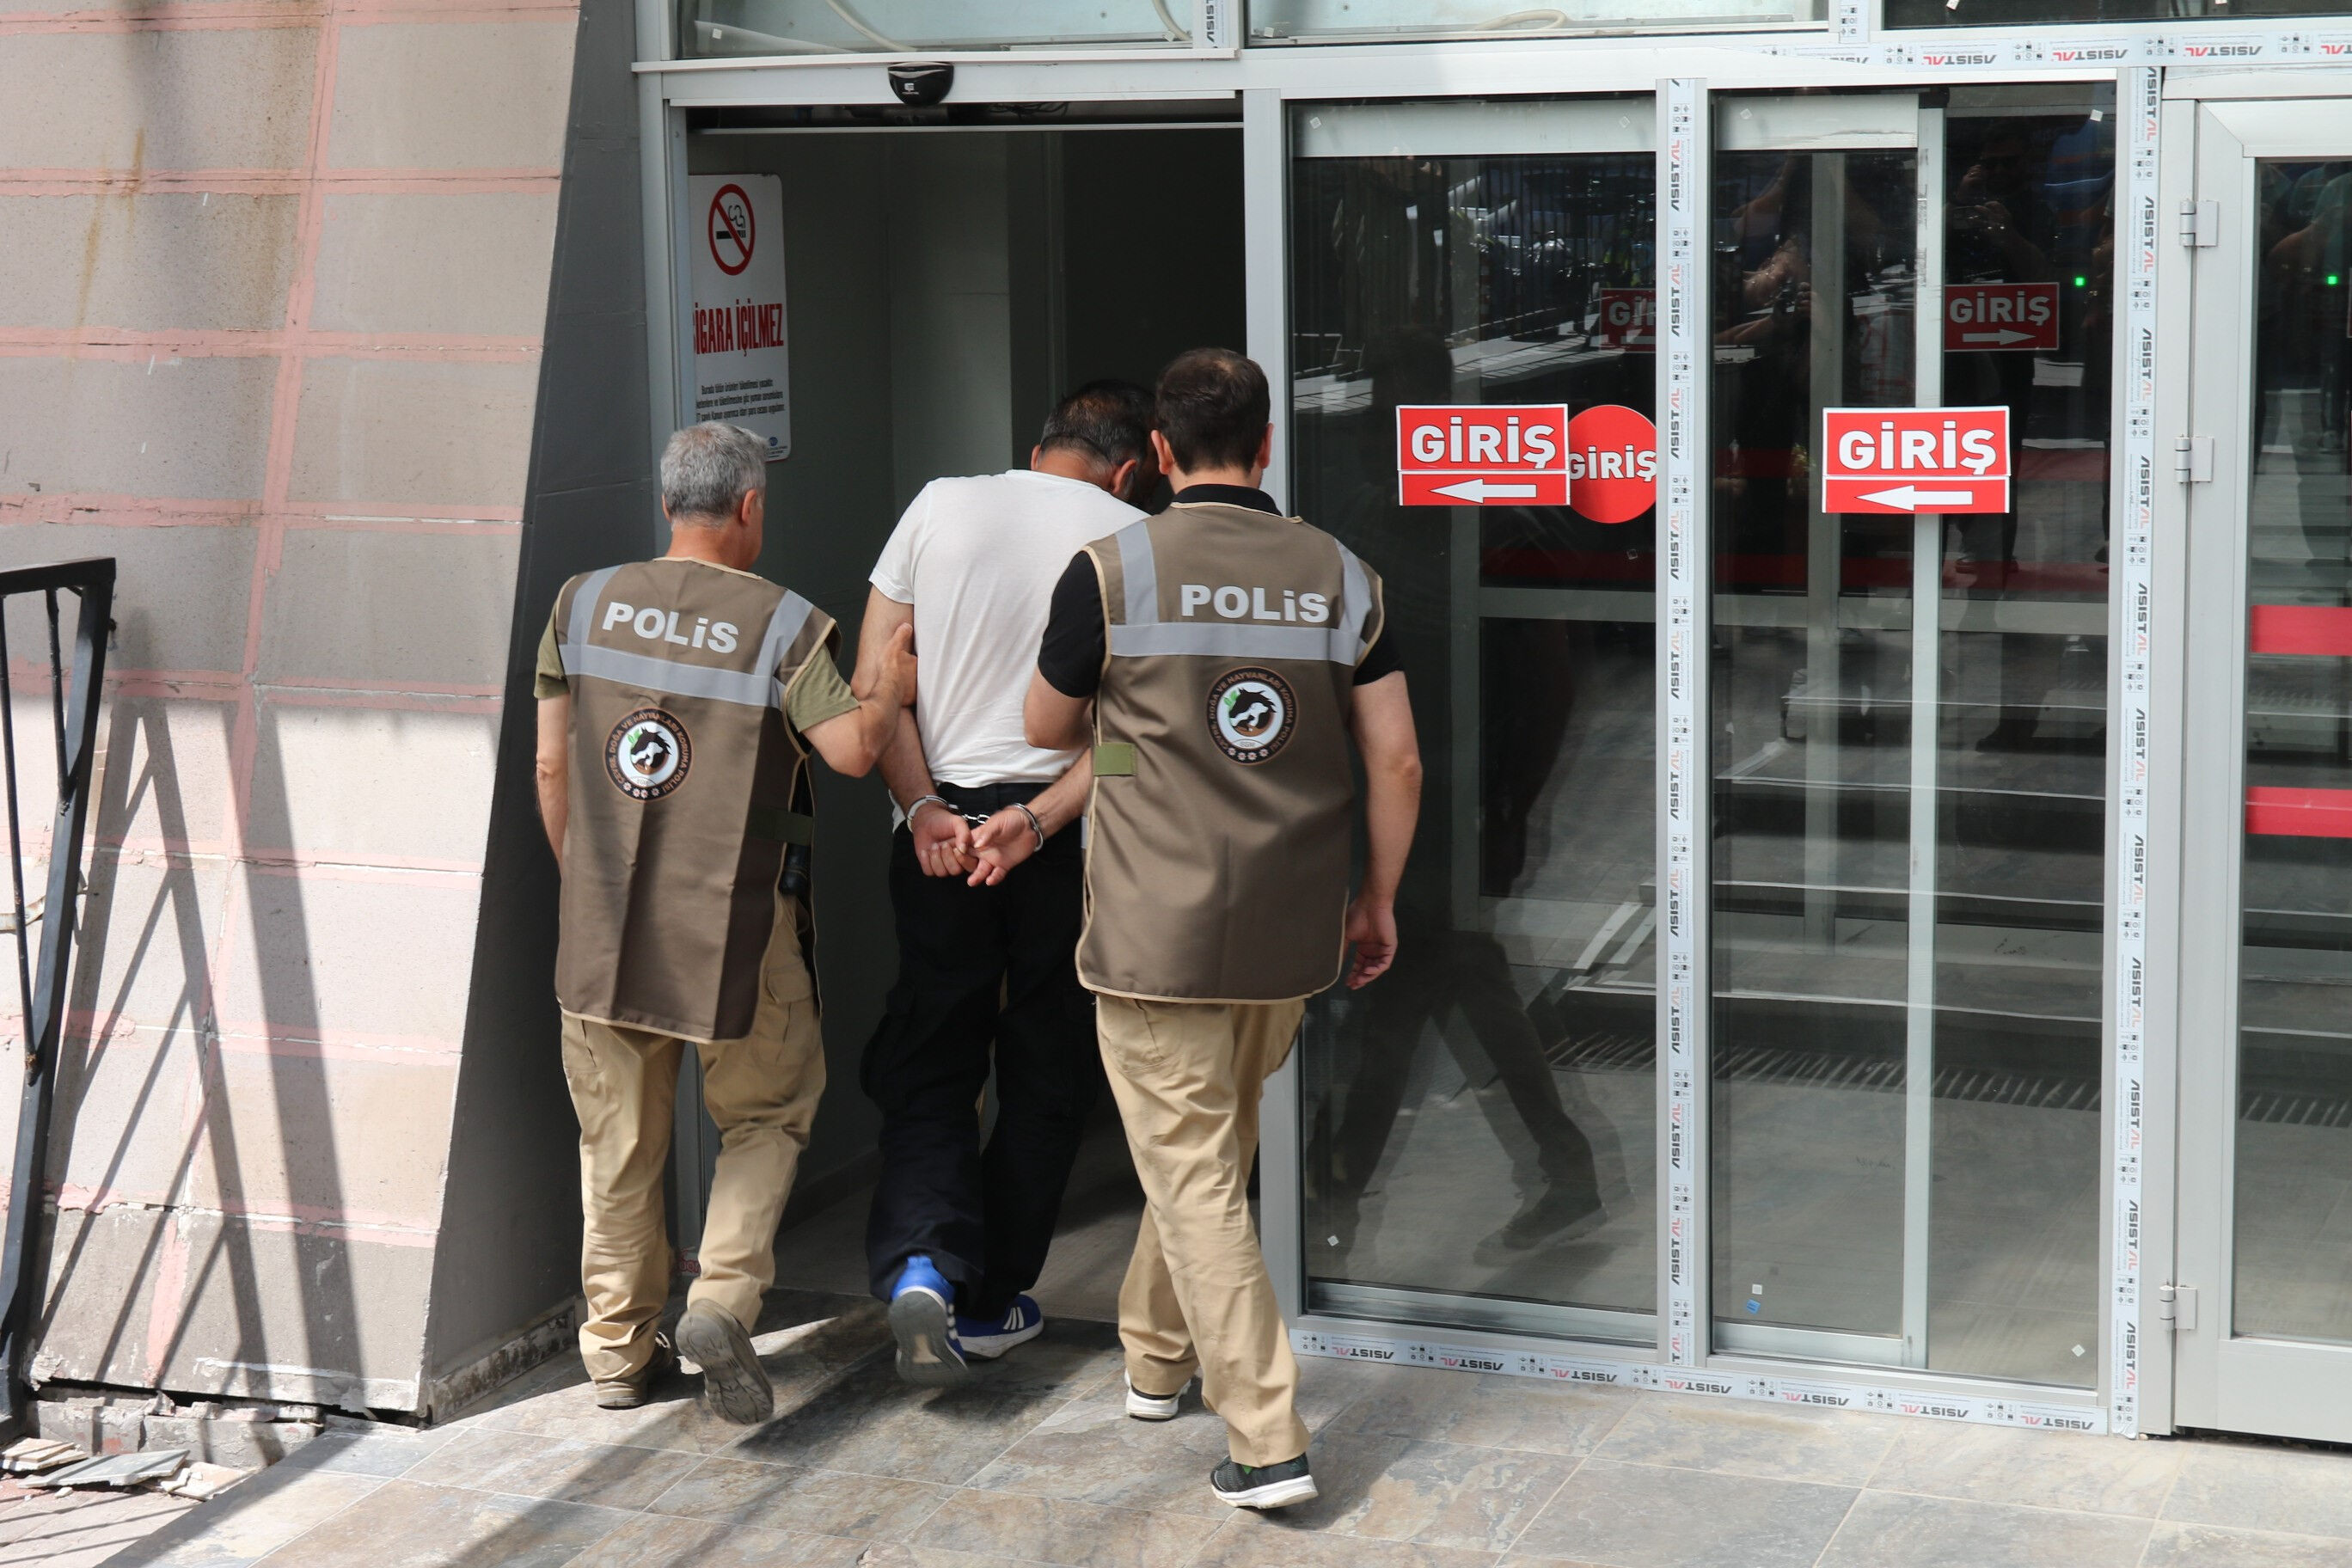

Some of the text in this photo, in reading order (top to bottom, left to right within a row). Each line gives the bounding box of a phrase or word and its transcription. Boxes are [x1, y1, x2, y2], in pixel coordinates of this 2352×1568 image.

[1924, 54, 1997, 65] ASISTAL
[2053, 49, 2128, 62] ASISTAL
[2185, 46, 2262, 58] ASISTAL
[1670, 140, 1681, 211] ASISTAL
[2144, 195, 2155, 273] ASISTAL
[693, 297, 784, 357] İGARA İÇİLMEZ
[1670, 264, 1681, 337] ASISTAL
[1949, 291, 2052, 326] GİRİŞ
[2141, 328, 2152, 401] ASISTAL
[1411, 416, 1557, 469] GİRİŞ
[1670, 389, 1680, 459] ASISTAL
[1838, 420, 1997, 475] GİRİŞ
[1569, 444, 1657, 482] GİRİŞ
[2140, 455, 2150, 529] ASISTAL
[1670, 511, 1679, 580] ASISTAL
[2137, 582, 2147, 655] ASISTAL
[1670, 631, 1680, 700] ASISTAL
[2135, 707, 2146, 781] ASISTAL
[1669, 750, 1679, 820] ASISTAL
[2134, 834, 2144, 904] ASISTAL
[1669, 869, 1679, 937] ASISTAL
[1671, 987, 1681, 1054] ASISTAL
[2131, 957, 2141, 1027] ASISTAL
[1671, 1104, 1681, 1169] ASISTAL
[2130, 1079, 2141, 1149] ASISTAL
[1670, 1218, 1681, 1285] ASISTAL
[2128, 1199, 2139, 1271] ASISTAL
[1332, 1348, 1393, 1359] ASISTAL
[1441, 1357, 1504, 1370] ASISTAL
[1551, 1369, 1617, 1382] ASISTAL
[2126, 1321, 2136, 1389] ASISTAL
[1664, 1381, 1732, 1394] ASISTAL
[1782, 1393, 1849, 1406] ASISTAL
[1900, 1405, 1969, 1418] ASISTAL
[2020, 1416, 2094, 1430] ASISTAL
